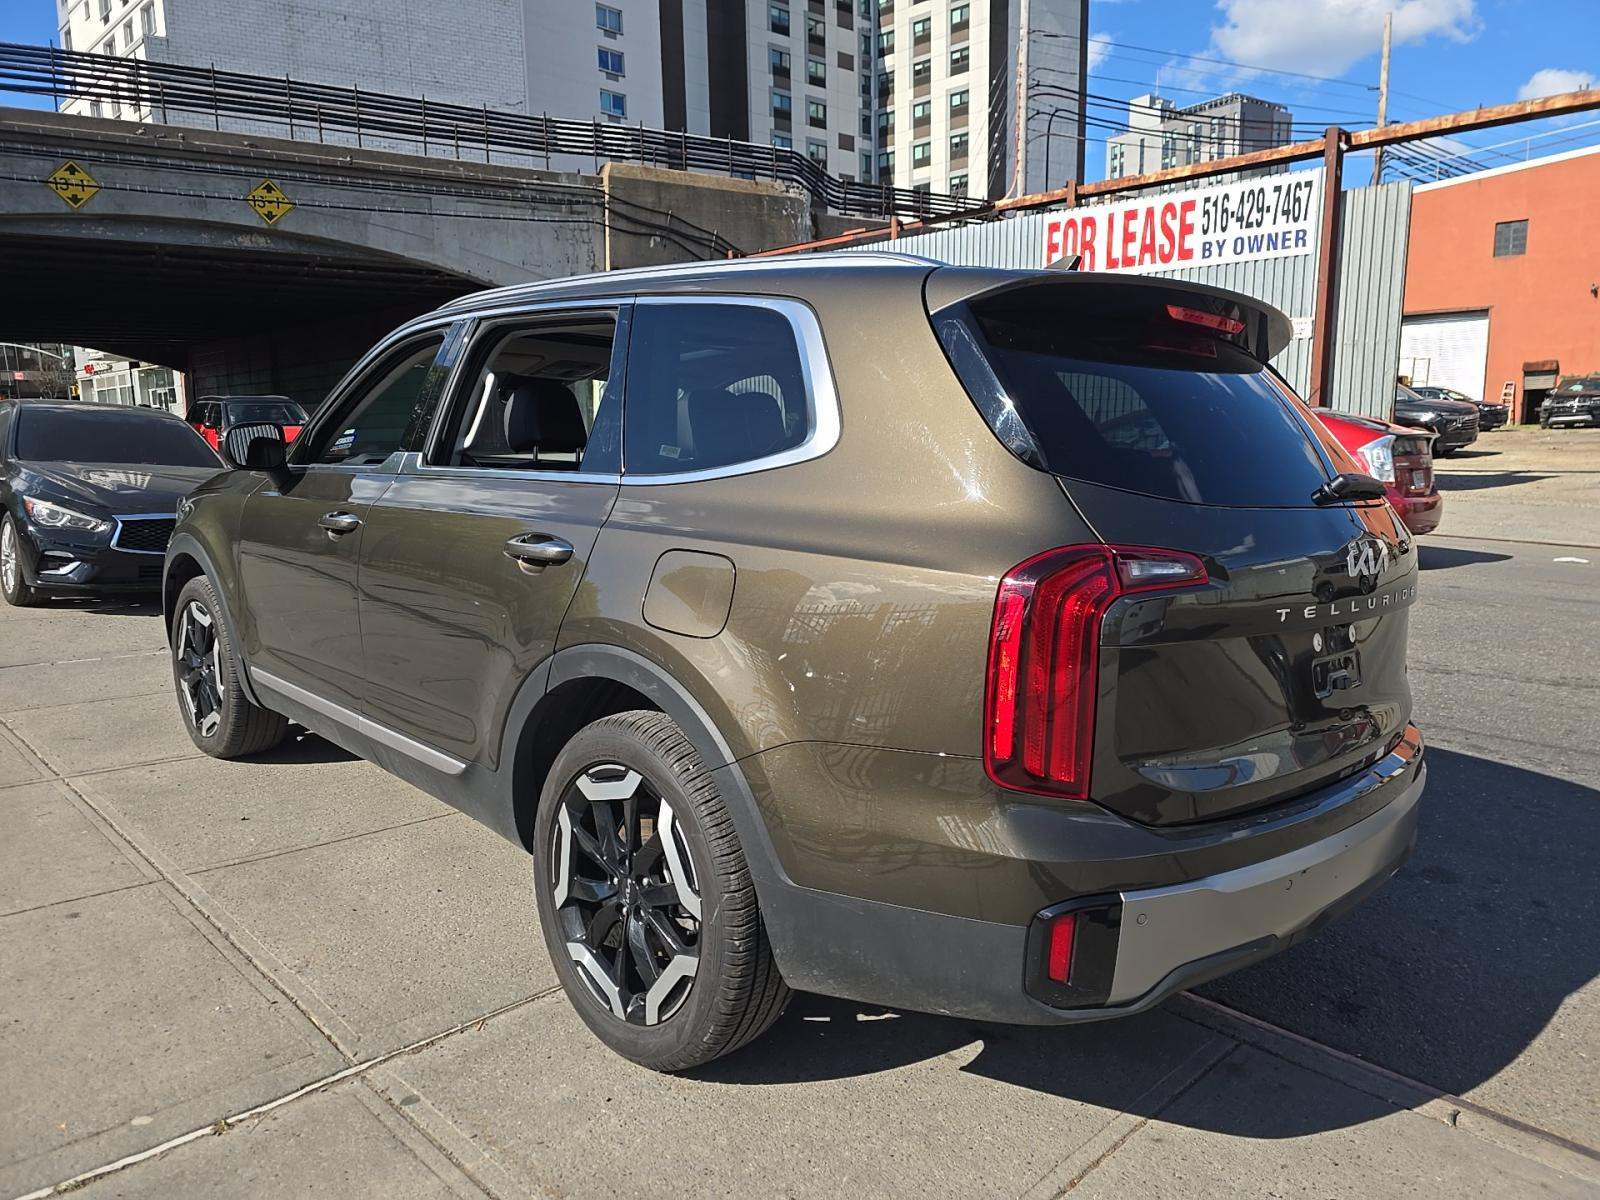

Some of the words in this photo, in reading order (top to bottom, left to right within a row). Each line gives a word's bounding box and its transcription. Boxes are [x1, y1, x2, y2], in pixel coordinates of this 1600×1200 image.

[1202, 180, 1313, 235] 516-429-7467
[1047, 216, 1096, 271] FOR
[1106, 200, 1196, 269] LEASE
[1202, 239, 1226, 259] BY
[1233, 229, 1307, 256] OWNER
[1276, 585, 1415, 622] TELLURIDE
